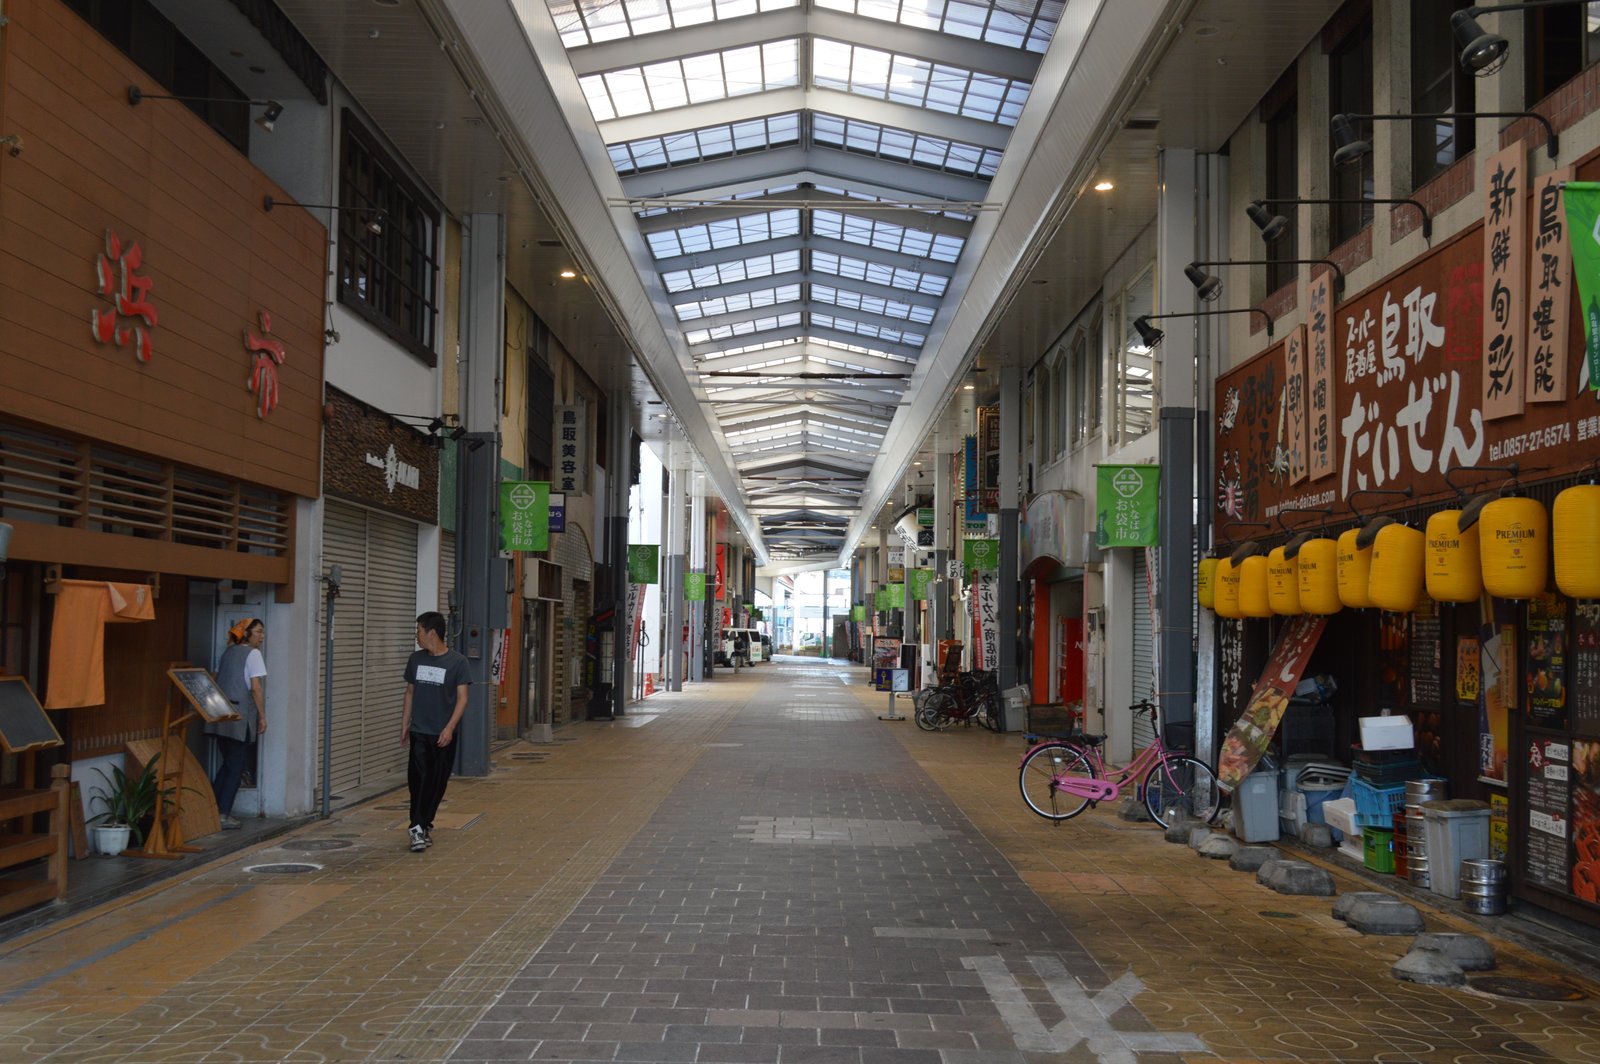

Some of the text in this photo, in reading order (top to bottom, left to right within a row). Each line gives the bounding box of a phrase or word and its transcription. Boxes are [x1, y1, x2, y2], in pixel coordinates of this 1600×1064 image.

[1487, 162, 1517, 400] 新鮮旬彩
[1532, 176, 1562, 395] 鳥取堪能
[1346, 308, 1376, 348] スーパー
[1377, 287, 1445, 388] 鳥取
[1345, 340, 1377, 384] 居酒屋
[561, 410, 577, 491] 鳥取美容室
[1341, 369, 1484, 502] だいぜん
[1489, 422, 1571, 462] tel.0857-27-6574
[512, 510, 523, 546] お袋市
[523, 511, 533, 546] いなばの
[1115, 498, 1128, 541] お袋市
[1129, 500, 1141, 541] いなばの
[1495, 528, 1535, 540] PREMIUM
[1428, 539, 1460, 549] PREMIUM
